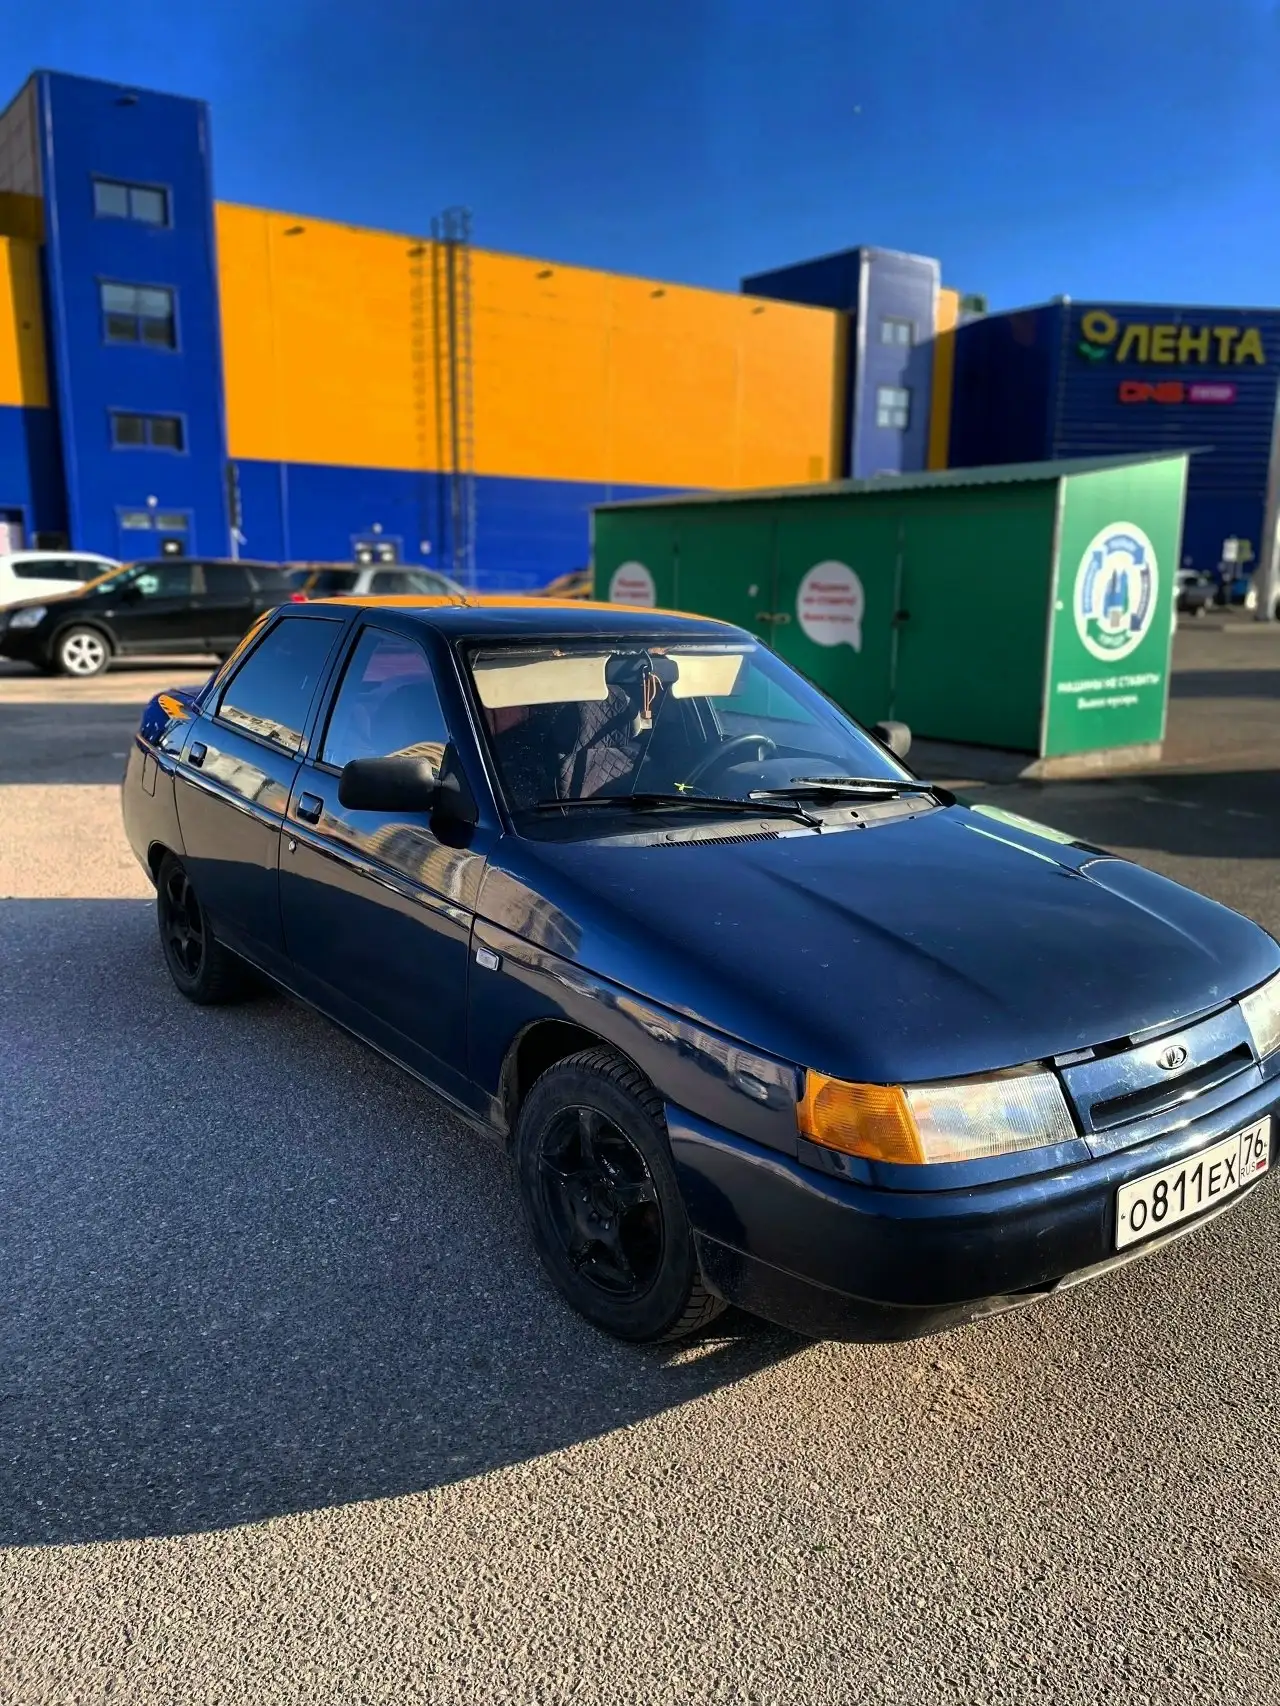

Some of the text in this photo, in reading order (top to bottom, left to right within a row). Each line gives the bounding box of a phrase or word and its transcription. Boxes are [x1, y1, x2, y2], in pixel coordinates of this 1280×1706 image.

[1116, 323, 1265, 364] ЛЕНТА
[1244, 1128, 1264, 1166] 76
[1240, 1160, 1256, 1178] RUS
